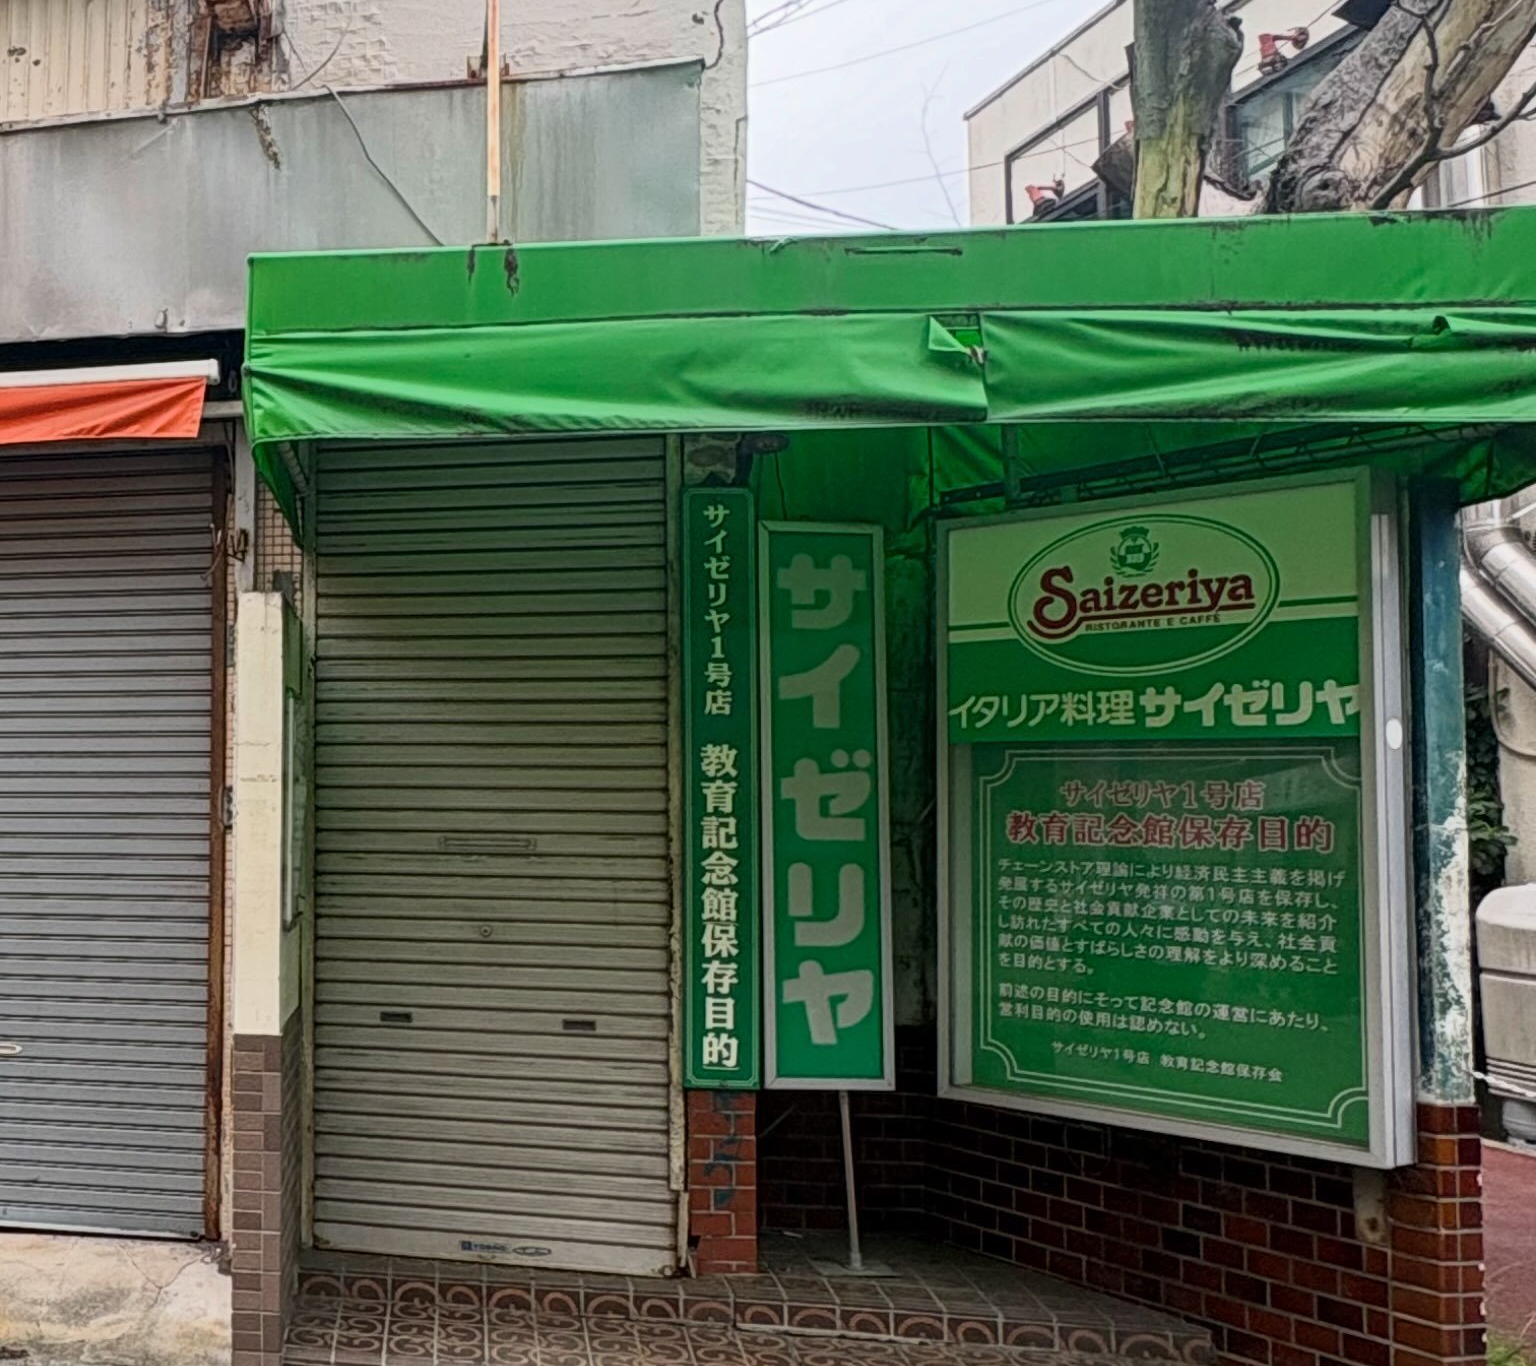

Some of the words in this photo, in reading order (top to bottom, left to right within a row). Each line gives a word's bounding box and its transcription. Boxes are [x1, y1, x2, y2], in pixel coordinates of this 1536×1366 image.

[703, 502, 733, 717] サイゼリヤ1号店
[1027, 565, 1256, 639] Saizeriya
[1085, 619, 1161, 633] RISTORANTE
[1167, 617, 1175, 627] E
[948, 688, 1135, 730] イタリア料理
[1139, 679, 1361, 727] サイゼリヤ
[776, 552, 875, 1046] サイゼリヤ
[1059, 780, 1264, 811] サイゼリヤ1号店
[1007, 810, 1334, 853] 教育記念館保存目的
[700, 743, 740, 1069] 教育記念館保存目的
